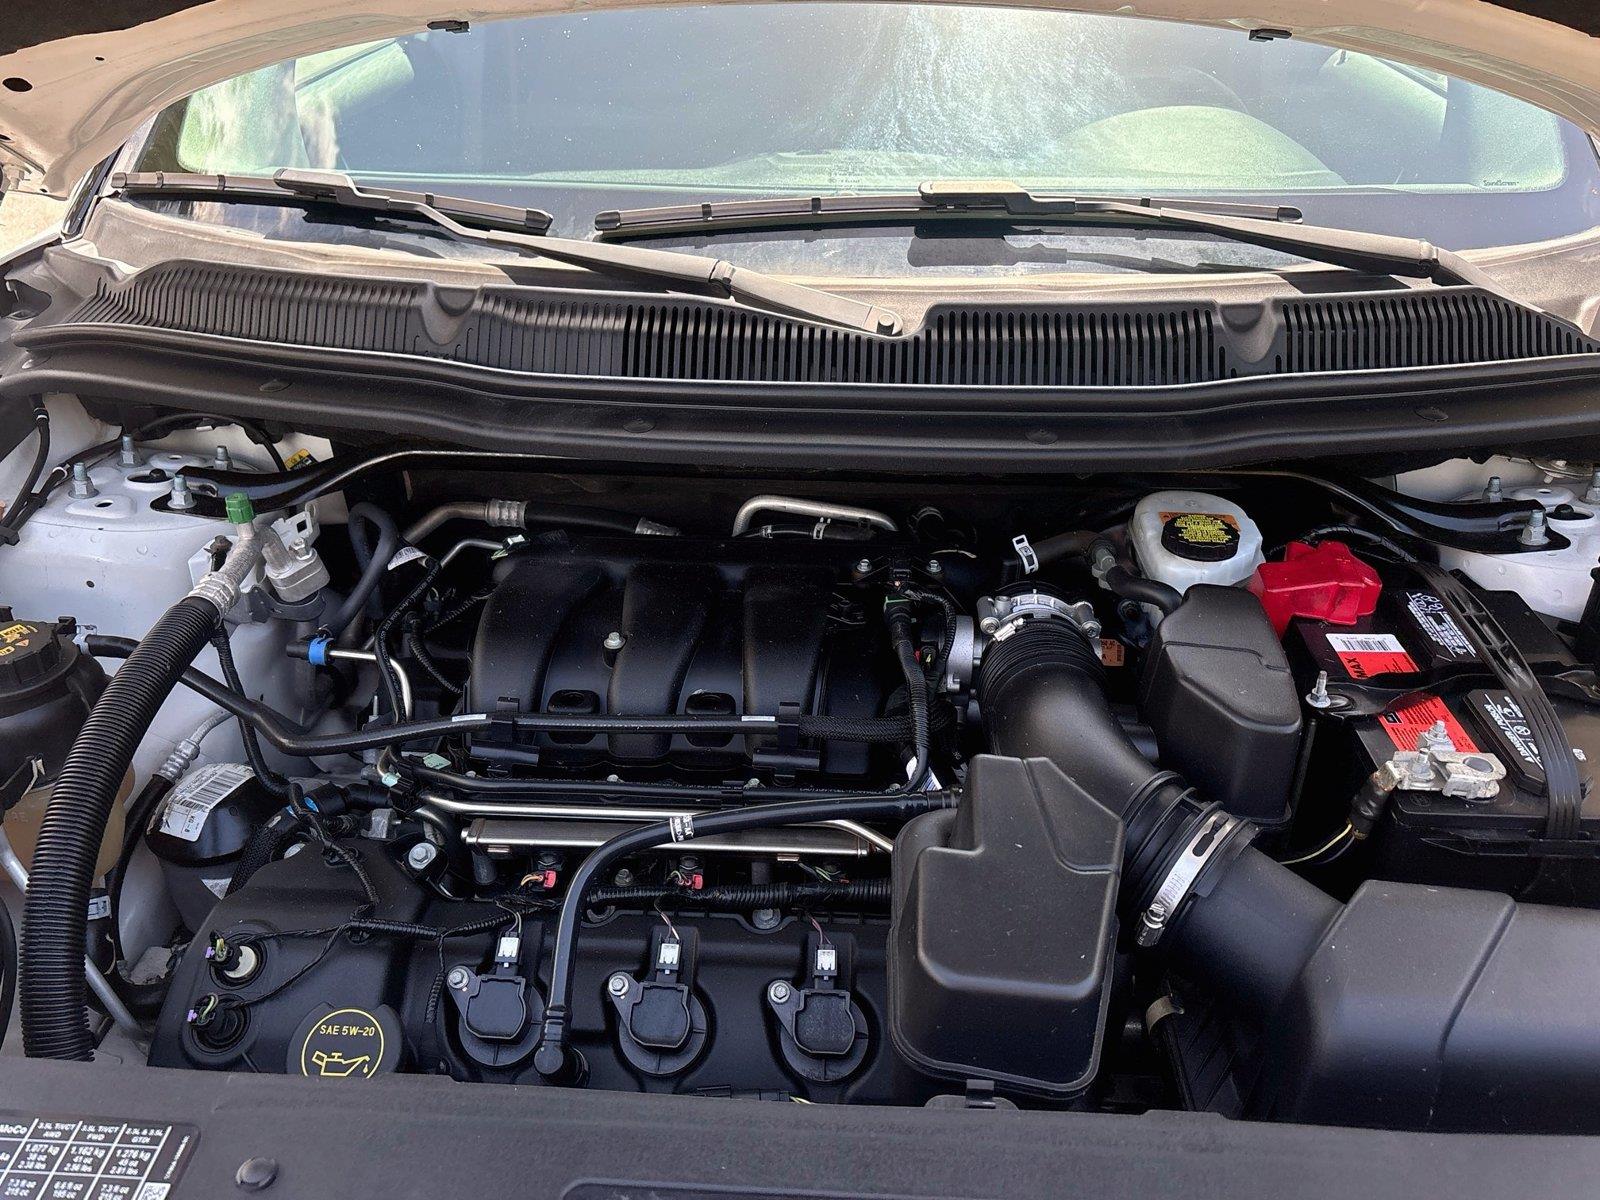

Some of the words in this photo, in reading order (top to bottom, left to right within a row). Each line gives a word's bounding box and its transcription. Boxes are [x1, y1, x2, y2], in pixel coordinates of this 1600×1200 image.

[320, 1025, 340, 1035] SAE
[342, 1026, 375, 1036] 5W-20
[86, 1133, 106, 1141] FWD
[47, 1145, 60, 1156] kg
[93, 1147, 106, 1159] kg
[139, 1150, 152, 1162] kg
